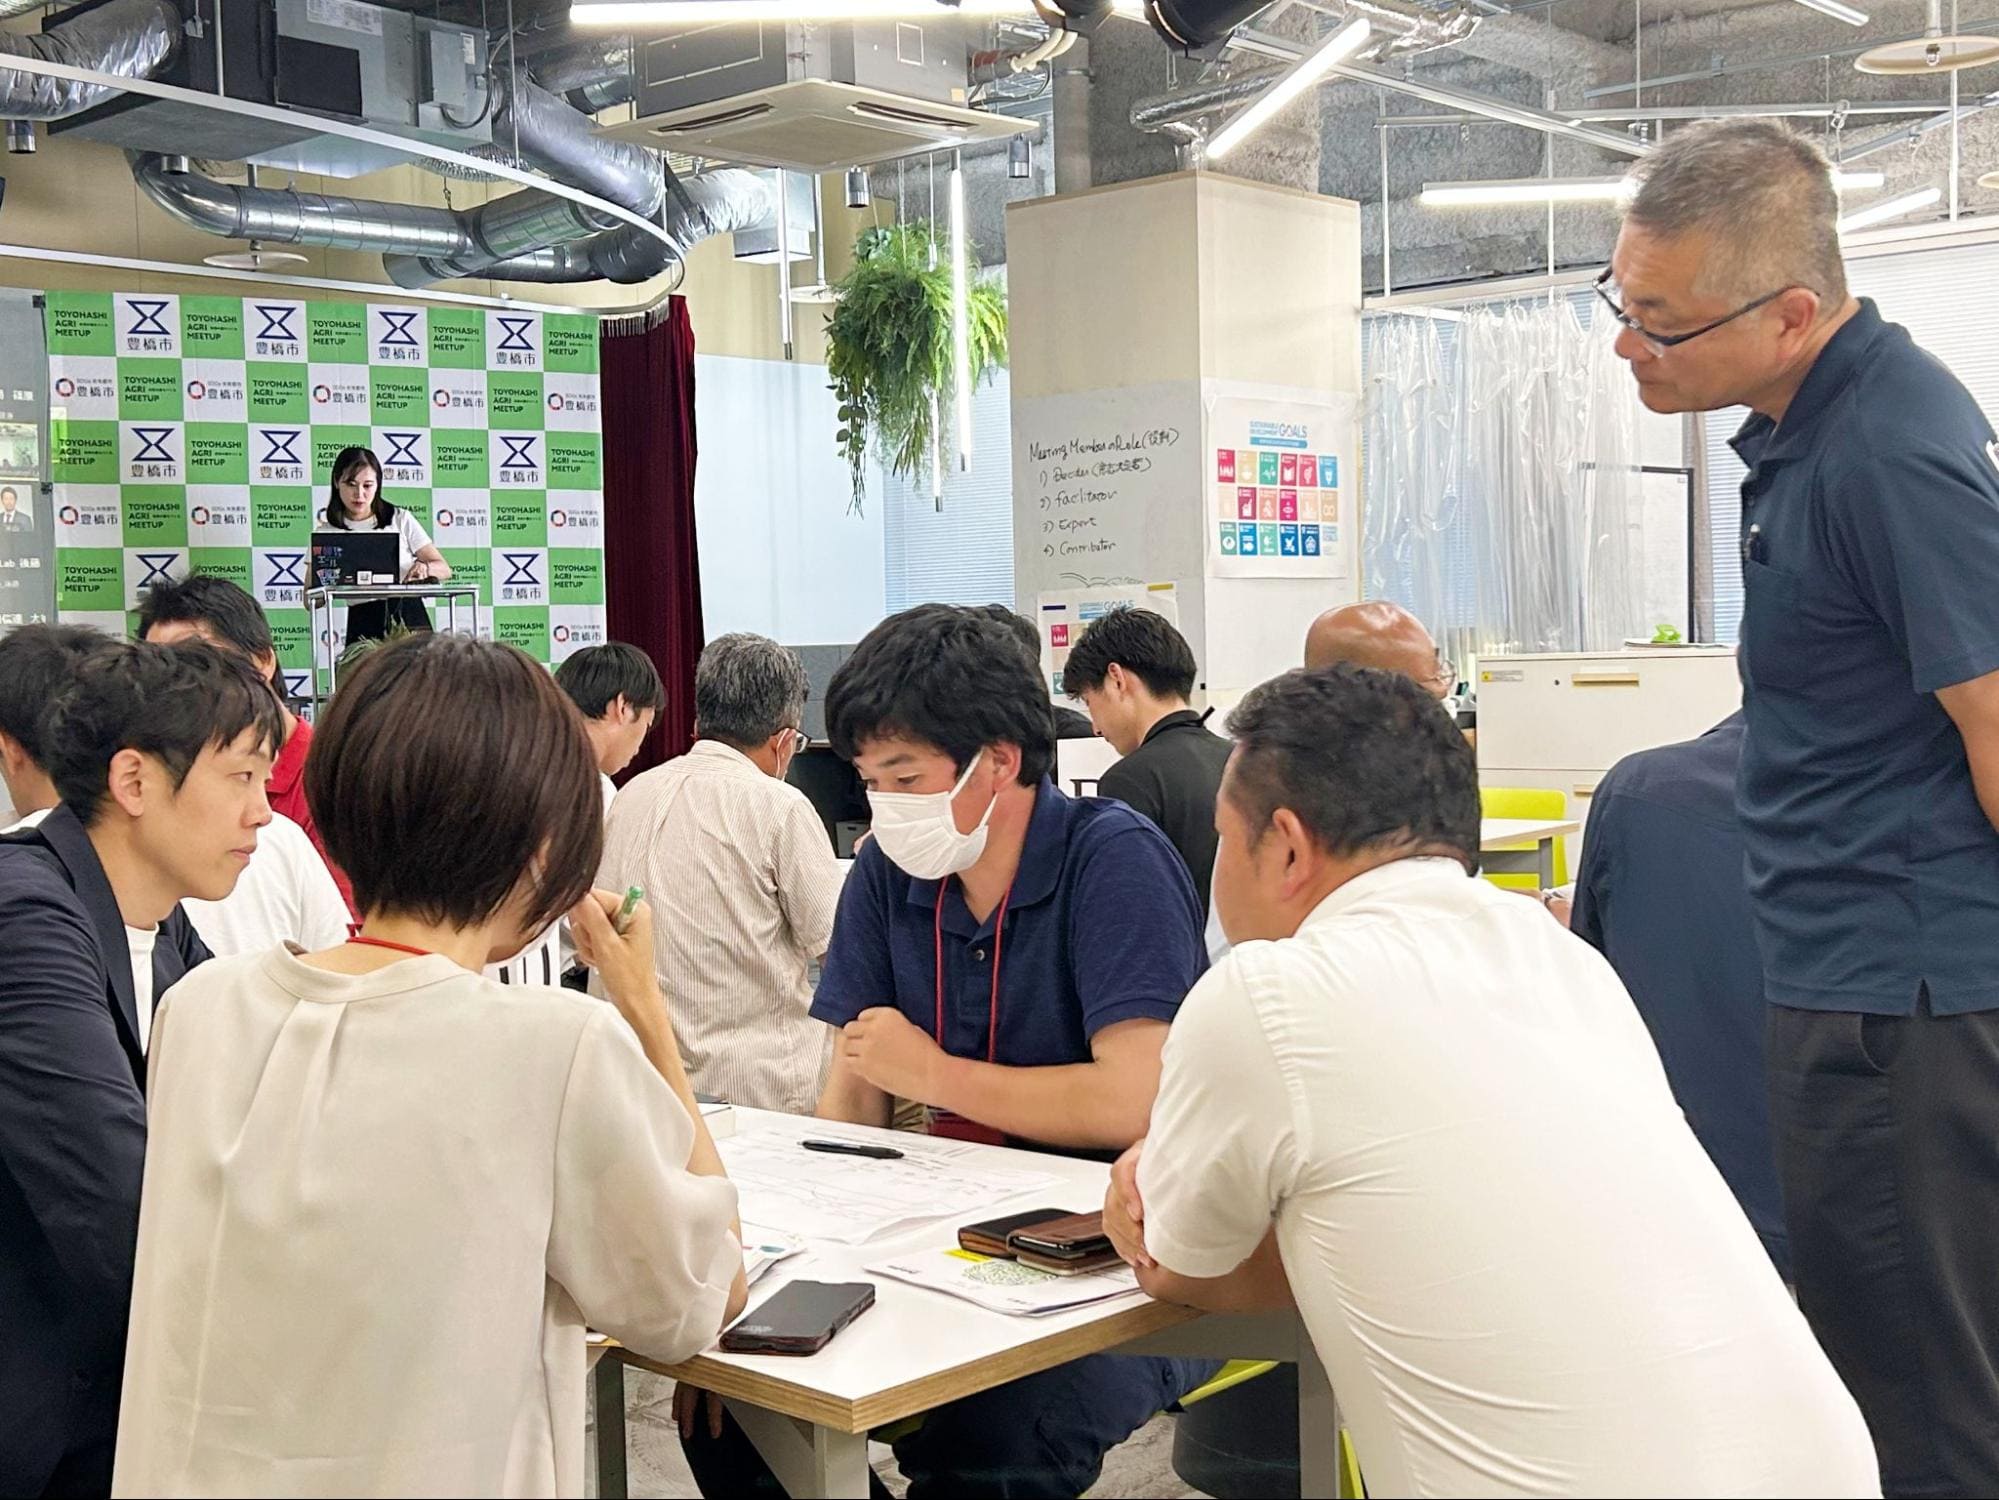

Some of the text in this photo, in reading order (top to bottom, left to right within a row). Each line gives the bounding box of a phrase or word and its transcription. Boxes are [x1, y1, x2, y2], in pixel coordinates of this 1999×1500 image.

[54, 310, 107, 319] TOYOHASHI
[187, 314, 237, 323] TOYOHASHI
[55, 319, 77, 327] AGRI
[187, 323, 208, 331] AGRI
[312, 320, 361, 329] TOYOHASHI
[55, 329, 91, 337] MEETUP
[433, 326, 479, 335] TOYOHASHI
[187, 332, 221, 340] MEETUP
[433, 334, 453, 342] AGRI
[549, 331, 593, 340] TOYOHASHI
[127, 338, 172, 351] 豊橋市
[434, 343, 464, 351] MEETUP
[549, 339, 567, 347] AGRI
[256, 341, 299, 355] 豊橋市
[378, 347, 420, 360] 豊橋市
[496, 352, 536, 365] 豊橋市
[125, 376, 176, 385] TOYOHASHI
[253, 380, 302, 389] TOYOHASHI
[125, 385, 146, 393] AGRI
[376, 384, 423, 392] TOYOHASHI
[376, 392, 396, 400] AGRI
[493, 388, 538, 397] TOYOHASHI
[125, 394, 159, 402] MEETUP
[254, 397, 286, 406] MEETUP
[493, 396, 512, 404] AGRI
[377, 401, 408, 409] MEETUP
[494, 405, 524, 413] MEETUP
[59, 439, 112, 447] TOYOHASHI
[191, 441, 242, 449] TOYOHASHI
[316, 443, 365, 451] TOYOH
[59, 448, 82, 456] AGRI
[191, 449, 212, 457] AGRI
[437, 446, 483, 455] TOYOHASHI
[551, 449, 595, 457] TOYOHASHI
[192, 458, 225, 466] MEETUP
[552, 457, 570, 465] AGRI
[131, 464, 177, 478] 豊橋市
[260, 466, 303, 479] 豊橋市
[382, 468, 424, 481] 豊橋市
[500, 471, 538, 483] 豊橋市
[128, 504, 180, 512] TOYOHASHI
[257, 504, 306, 512] TOYOHASHI
[496, 507, 541, 515] TOYOHASHI
[129, 512, 150, 520] AGRI
[65, 567, 118, 575] TOYOHASHI
[554, 565, 597, 573] TOYOHASHI
[65, 584, 100, 592] MEETUP
[502, 587, 542, 600] 豊橋市
[500, 623, 545, 632] TOYOHASHI
